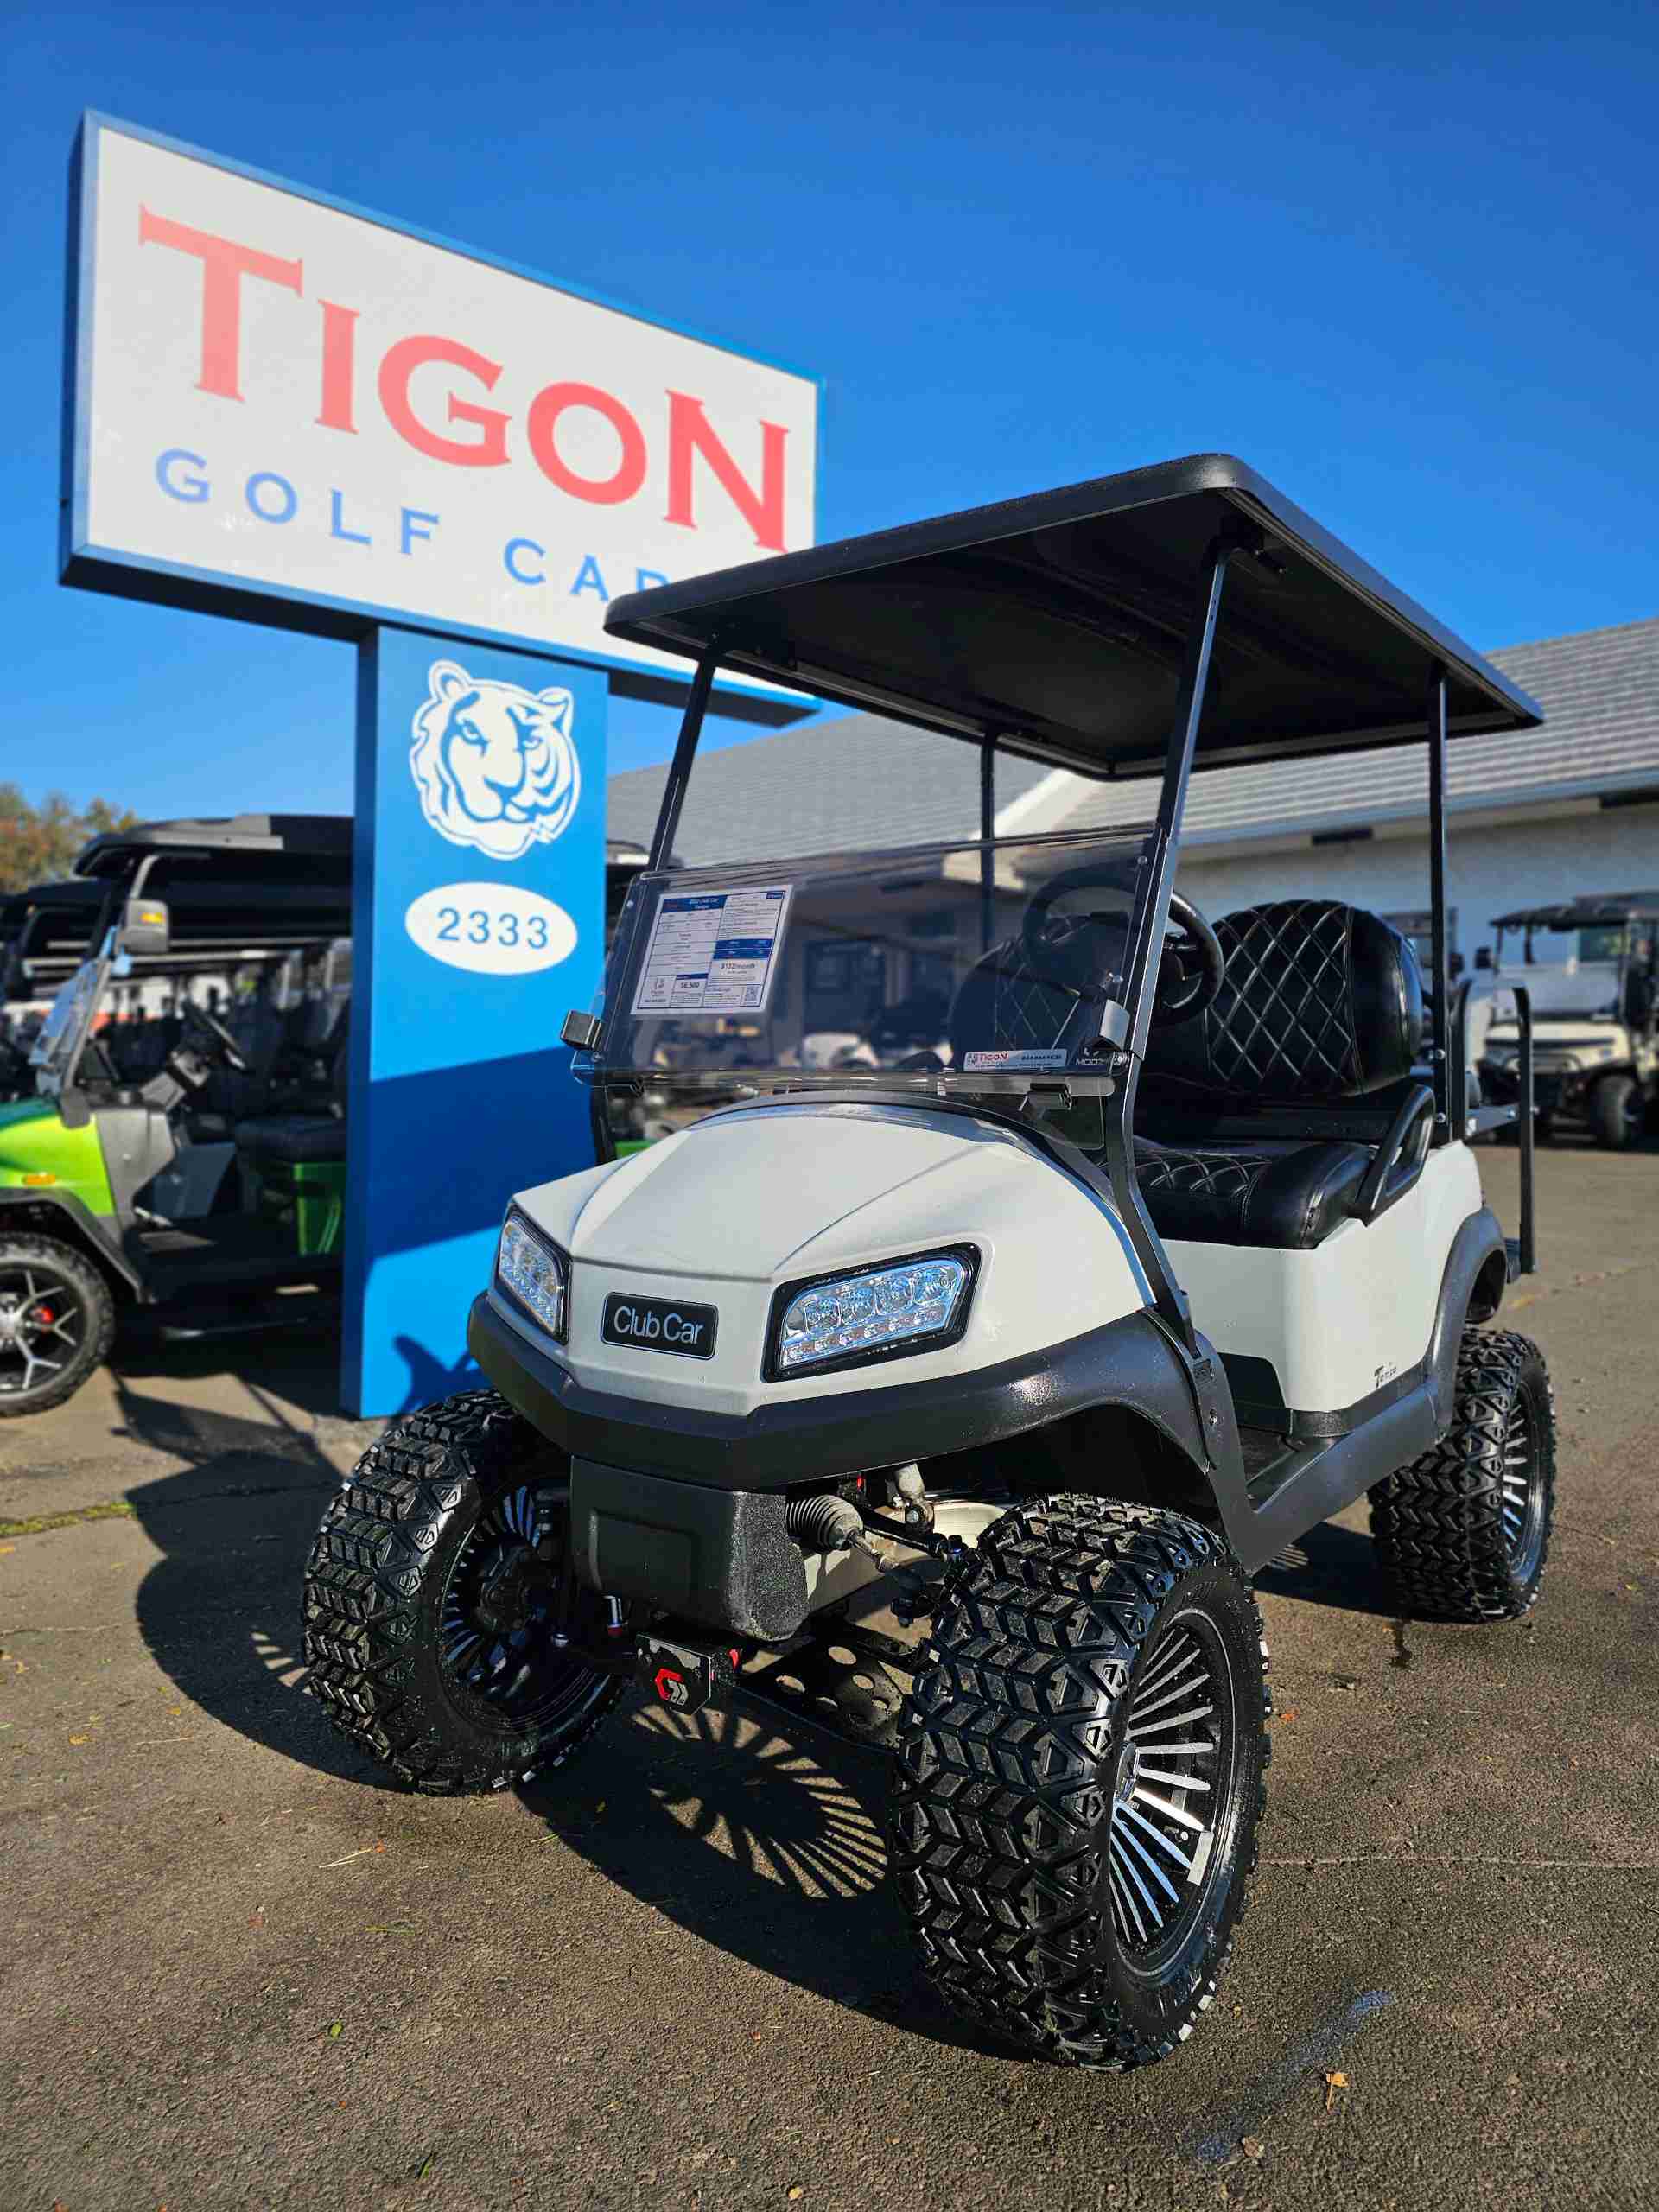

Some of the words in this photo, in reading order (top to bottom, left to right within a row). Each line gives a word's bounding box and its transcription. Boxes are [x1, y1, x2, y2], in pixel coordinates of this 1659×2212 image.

[139, 204, 791, 554] TIGON
[156, 448, 440, 555] GOLF
[437, 907, 548, 949] 2333
[978, 1052, 1009, 1062] TIGON
[613, 1306, 661, 1338] Club
[663, 1313, 704, 1344] Car
